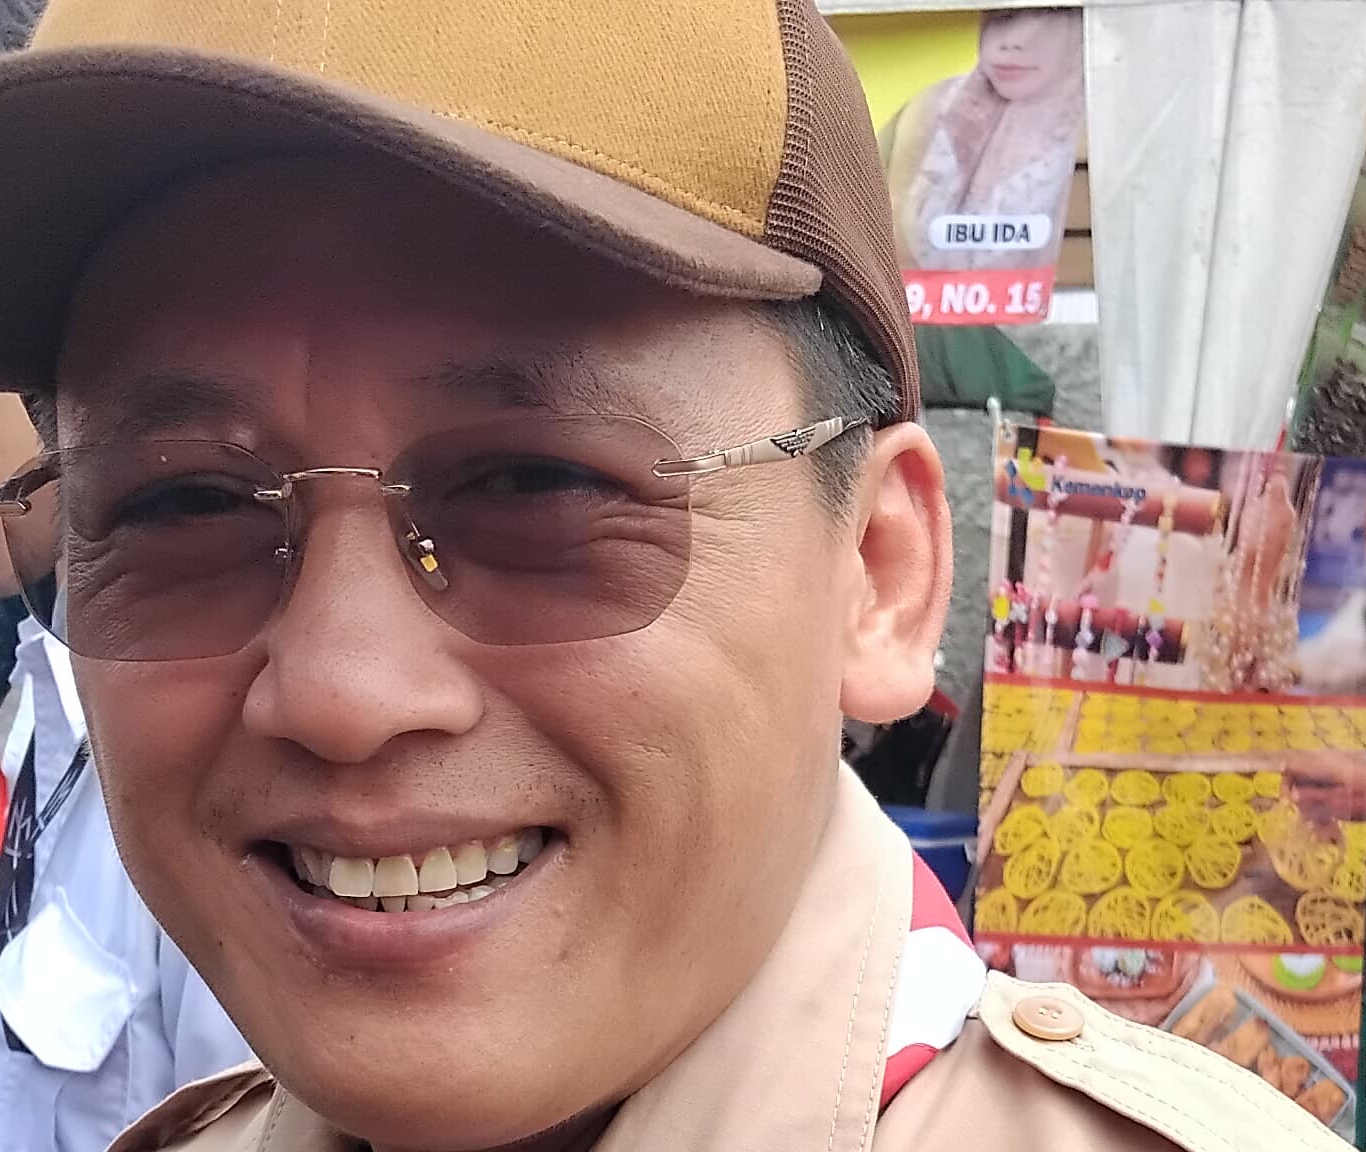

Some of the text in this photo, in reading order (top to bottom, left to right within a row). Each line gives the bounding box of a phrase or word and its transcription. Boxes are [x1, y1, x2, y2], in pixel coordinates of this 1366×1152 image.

[946, 223, 1031, 243] IBU IDA
[940, 283, 997, 315] NO.
